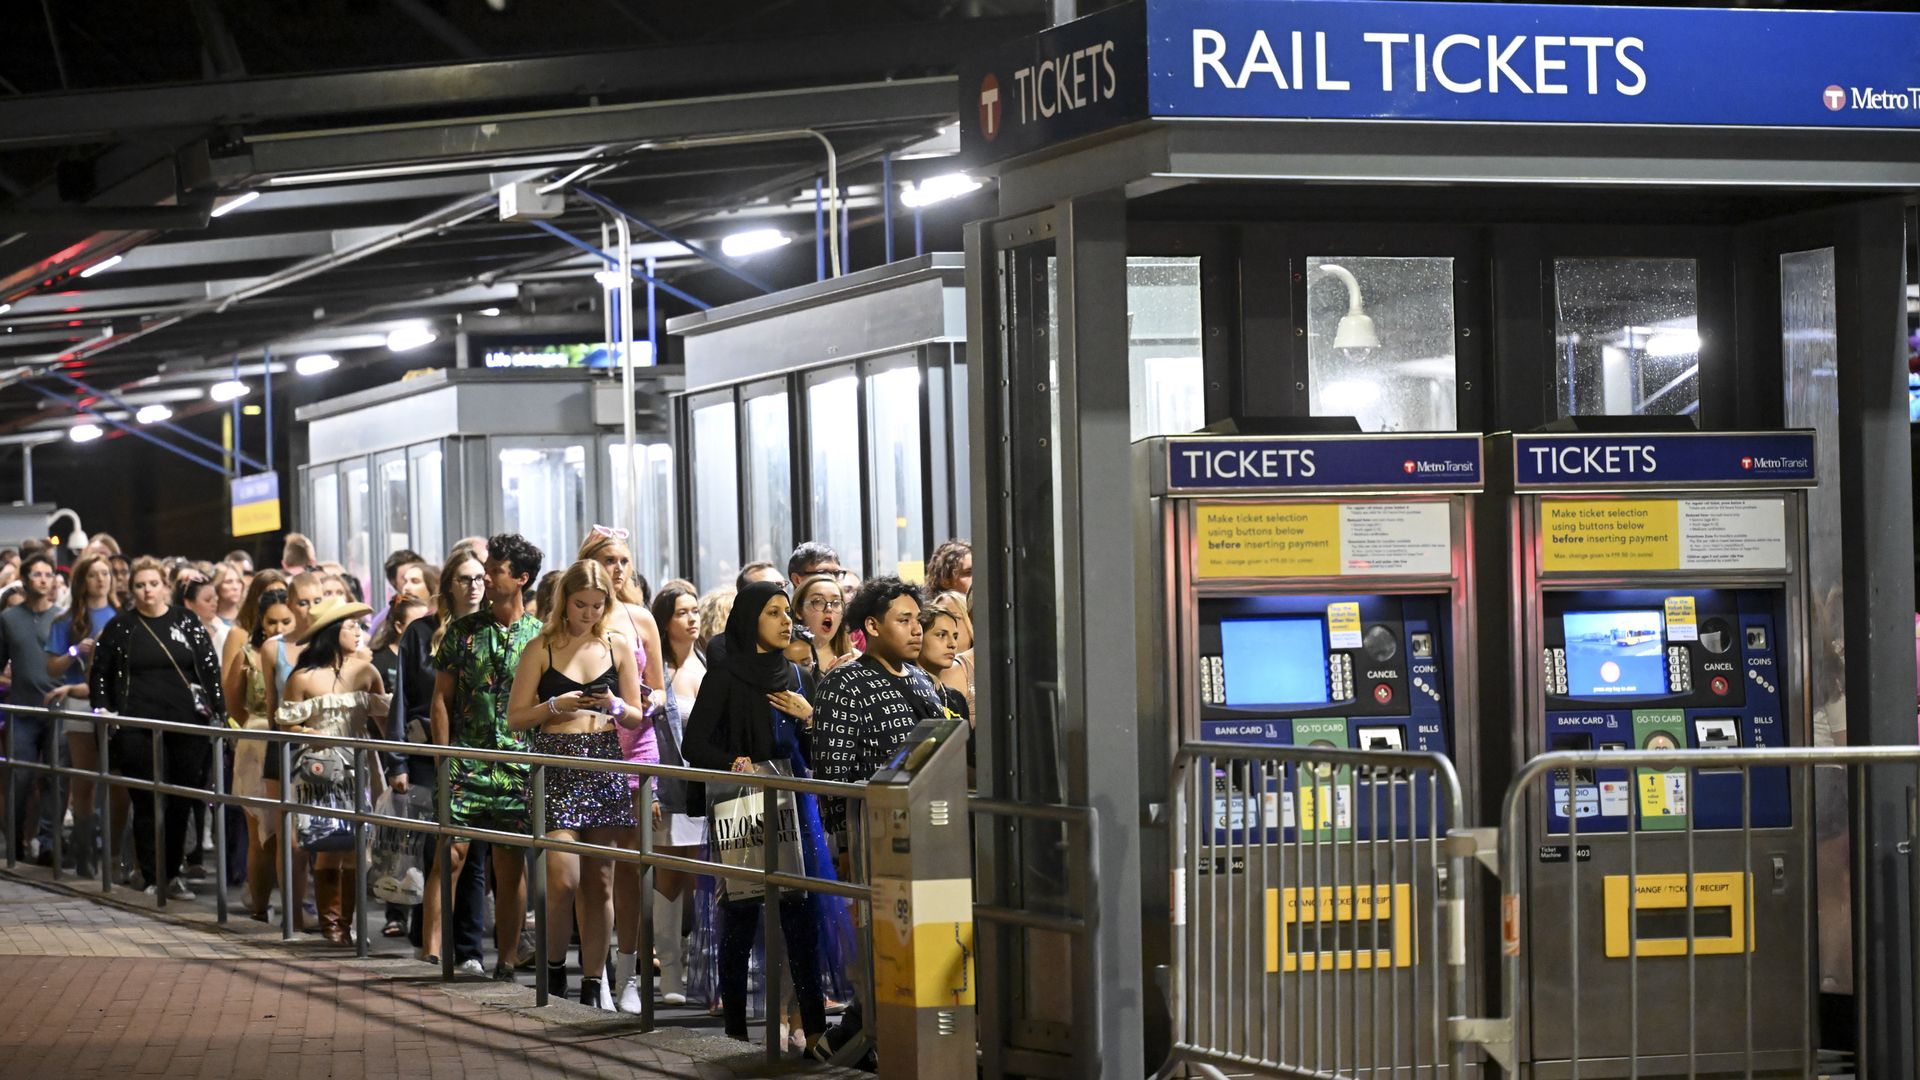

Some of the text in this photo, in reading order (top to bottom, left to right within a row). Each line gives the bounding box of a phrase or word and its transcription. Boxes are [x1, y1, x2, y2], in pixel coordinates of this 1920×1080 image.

[1193, 28, 1647, 96] RAIL TICKETS
[1014, 40, 1116, 124] TICKETS
[1182, 450, 1316, 478] TICKETS
[1528, 445, 1657, 474] TICKETS
[1208, 513, 1308, 523] Make ticket selection
[1552, 508, 1648, 518] Make ticket selection
[1552, 520, 1644, 532] using buttons below
[1208, 526, 1304, 538] using buttons below
[1552, 534, 1668, 544] before inserting payment
[1208, 540, 1329, 550] before inserting payment
[1704, 663, 1734, 671] CANCEL
[1748, 658, 1772, 666] COINS
[1367, 670, 1398, 678] CANCEL
[1558, 716, 1604, 726] BANK CARD
[1636, 714, 1682, 724] GO-TO CARD
[1754, 716, 1774, 724] BILLS
[1215, 726, 1262, 736] BANK CARD
[1296, 724, 1344, 733] GO-TO CARD
[1418, 725, 1439, 733] BILLS
[1634, 886, 1662, 894] HANGE
[1700, 884, 1730, 892] RECEIPT
